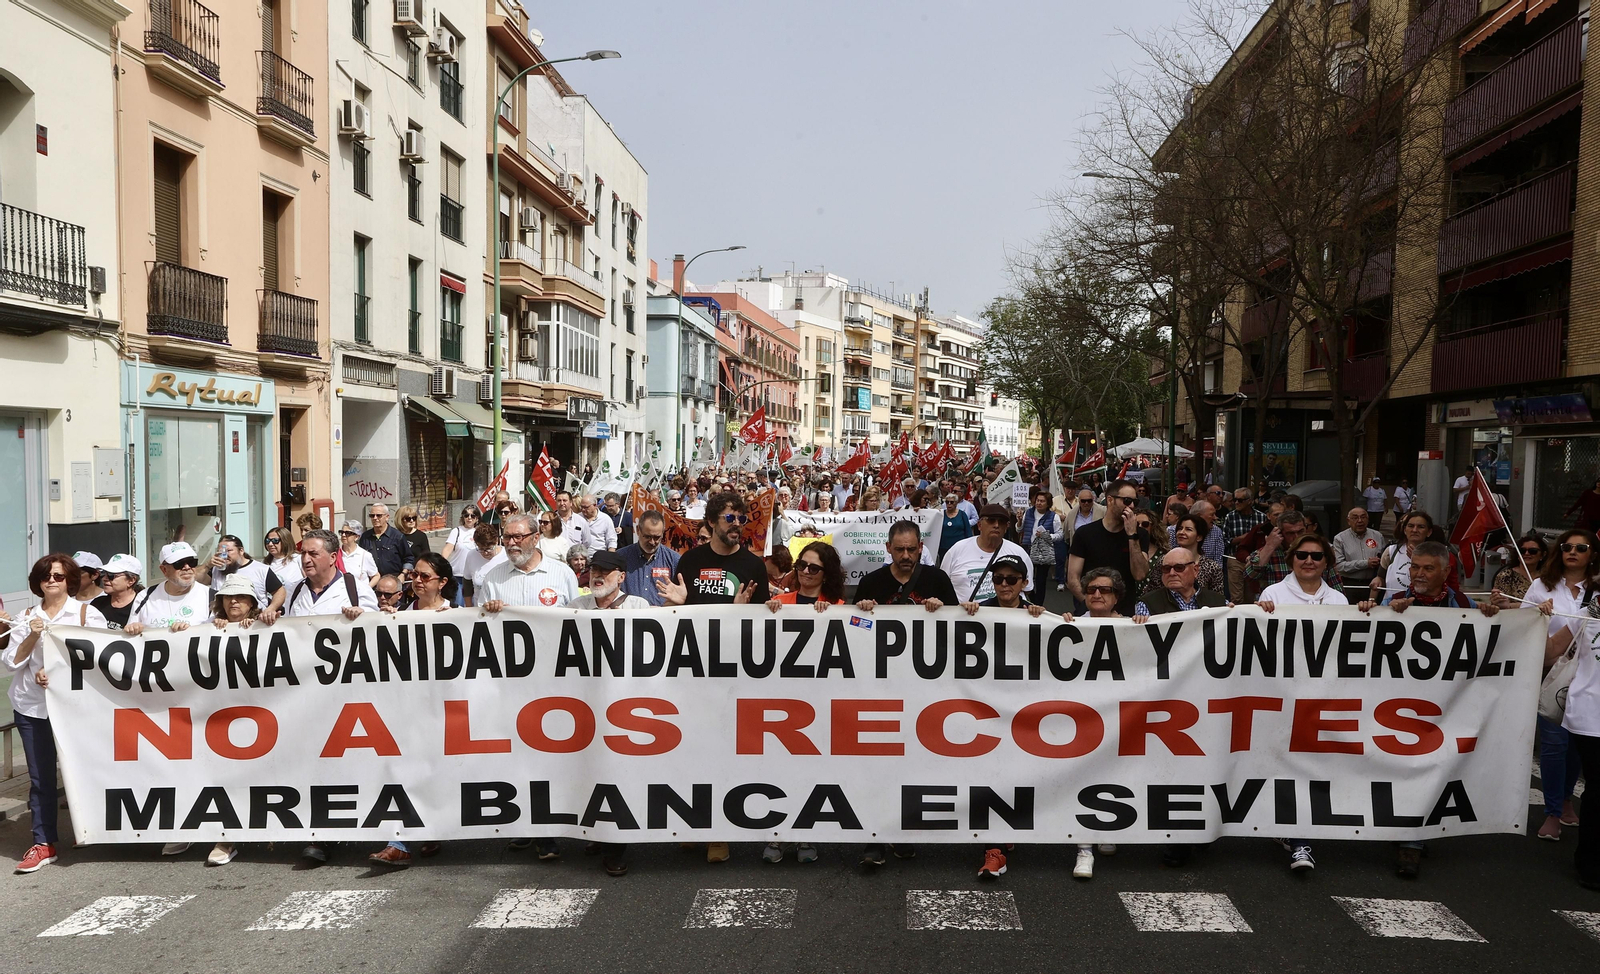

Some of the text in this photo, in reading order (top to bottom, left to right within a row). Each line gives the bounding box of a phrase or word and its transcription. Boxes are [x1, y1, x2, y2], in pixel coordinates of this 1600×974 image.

[146, 373, 262, 406] Rytual
[66, 409, 72, 422] 3
[822, 516, 850, 524] DEL
[694, 578, 725, 587] SOUTH
[699, 586, 725, 595] FACE
[65, 617, 1516, 693] POR UNA SANIDAD ANDALUZA PUBLICA Y UNIVERSAL.
[113, 695, 1477, 762] NO A LOS RECORTES.
[105, 778, 1478, 832] MAREA BLANCA EN SEVILLA
